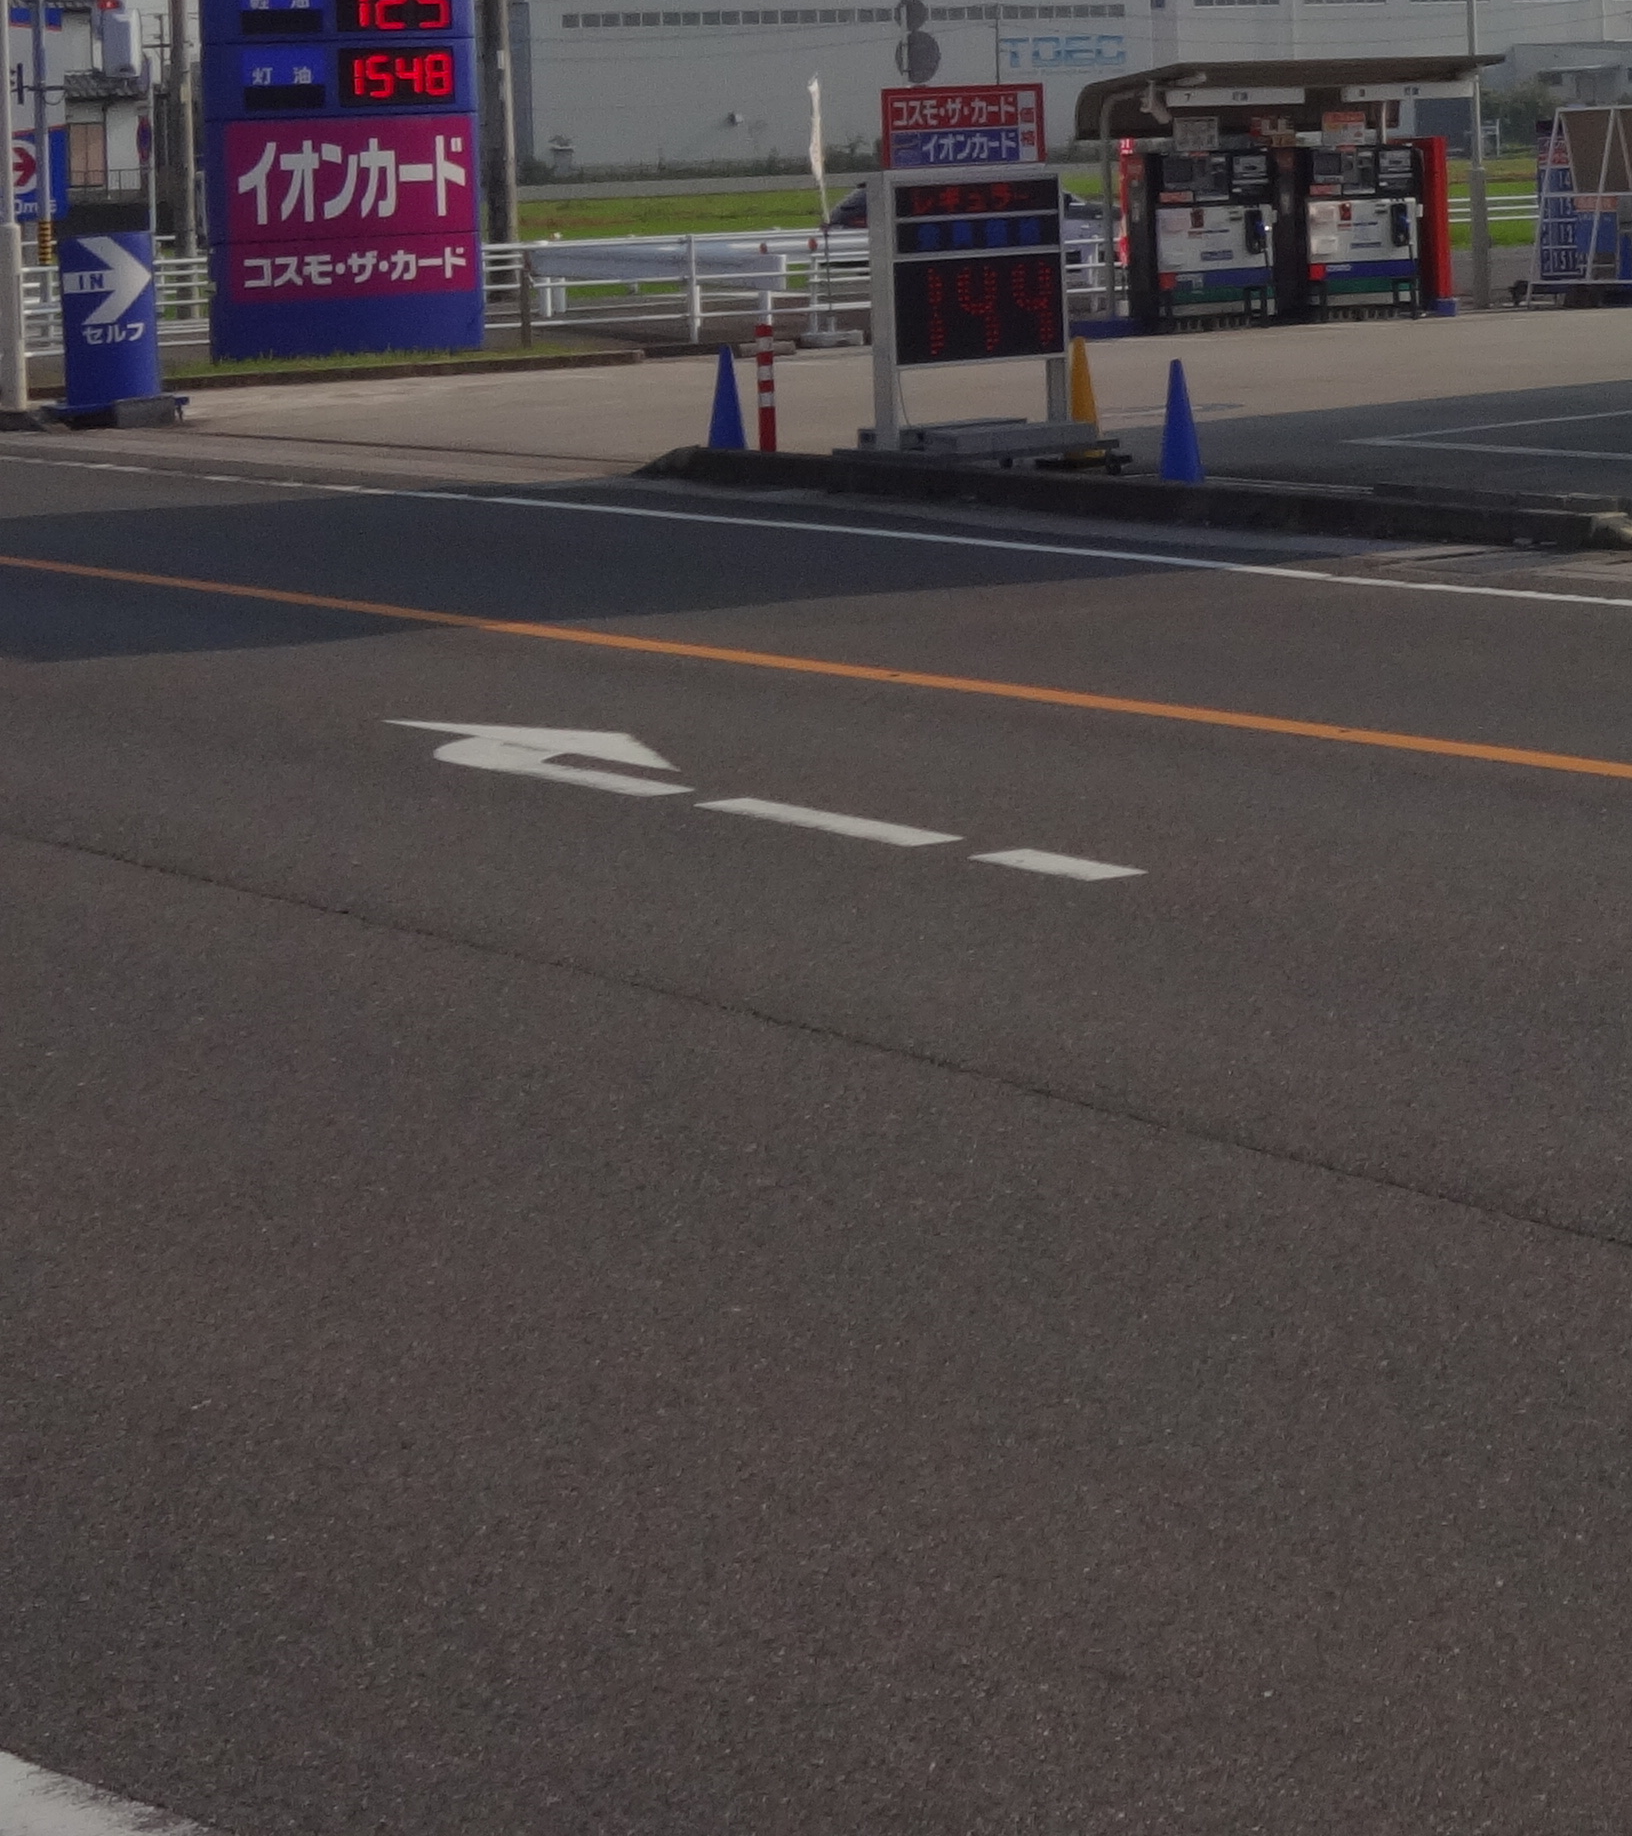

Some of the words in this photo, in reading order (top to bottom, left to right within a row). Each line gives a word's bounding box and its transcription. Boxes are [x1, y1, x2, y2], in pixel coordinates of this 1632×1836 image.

[892, 95, 1016, 127] コスモ・ザ・カード
[922, 130, 1018, 161] イオンカード
[237, 135, 467, 226] イオンカード
[78, 273, 105, 291] IN
[243, 246, 467, 289] コスモ・ザ・カード
[927, 260, 1054, 356] 144
[82, 321, 146, 346] セルフ
